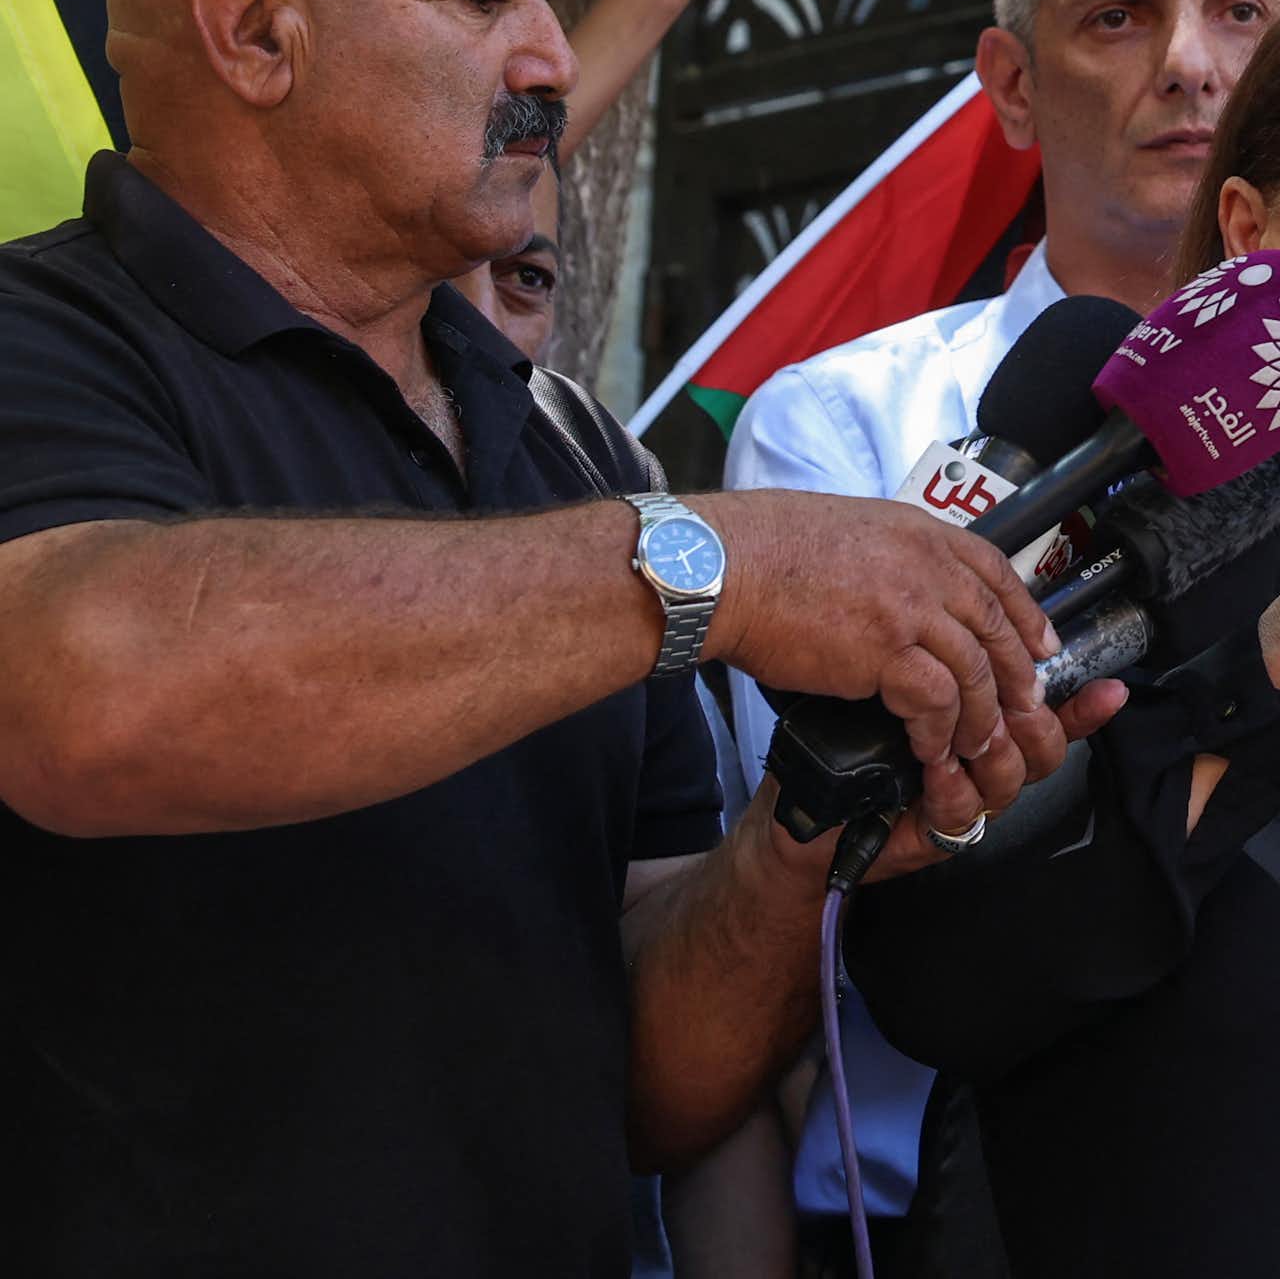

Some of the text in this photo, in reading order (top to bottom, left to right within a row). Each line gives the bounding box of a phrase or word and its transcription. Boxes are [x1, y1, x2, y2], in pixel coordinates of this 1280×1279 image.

[1179, 404, 1220, 460] alfajertv.com
[1192, 387, 1257, 447] الفجر
[948, 507, 973, 524] WAT
[1079, 547, 1124, 580] SONY
